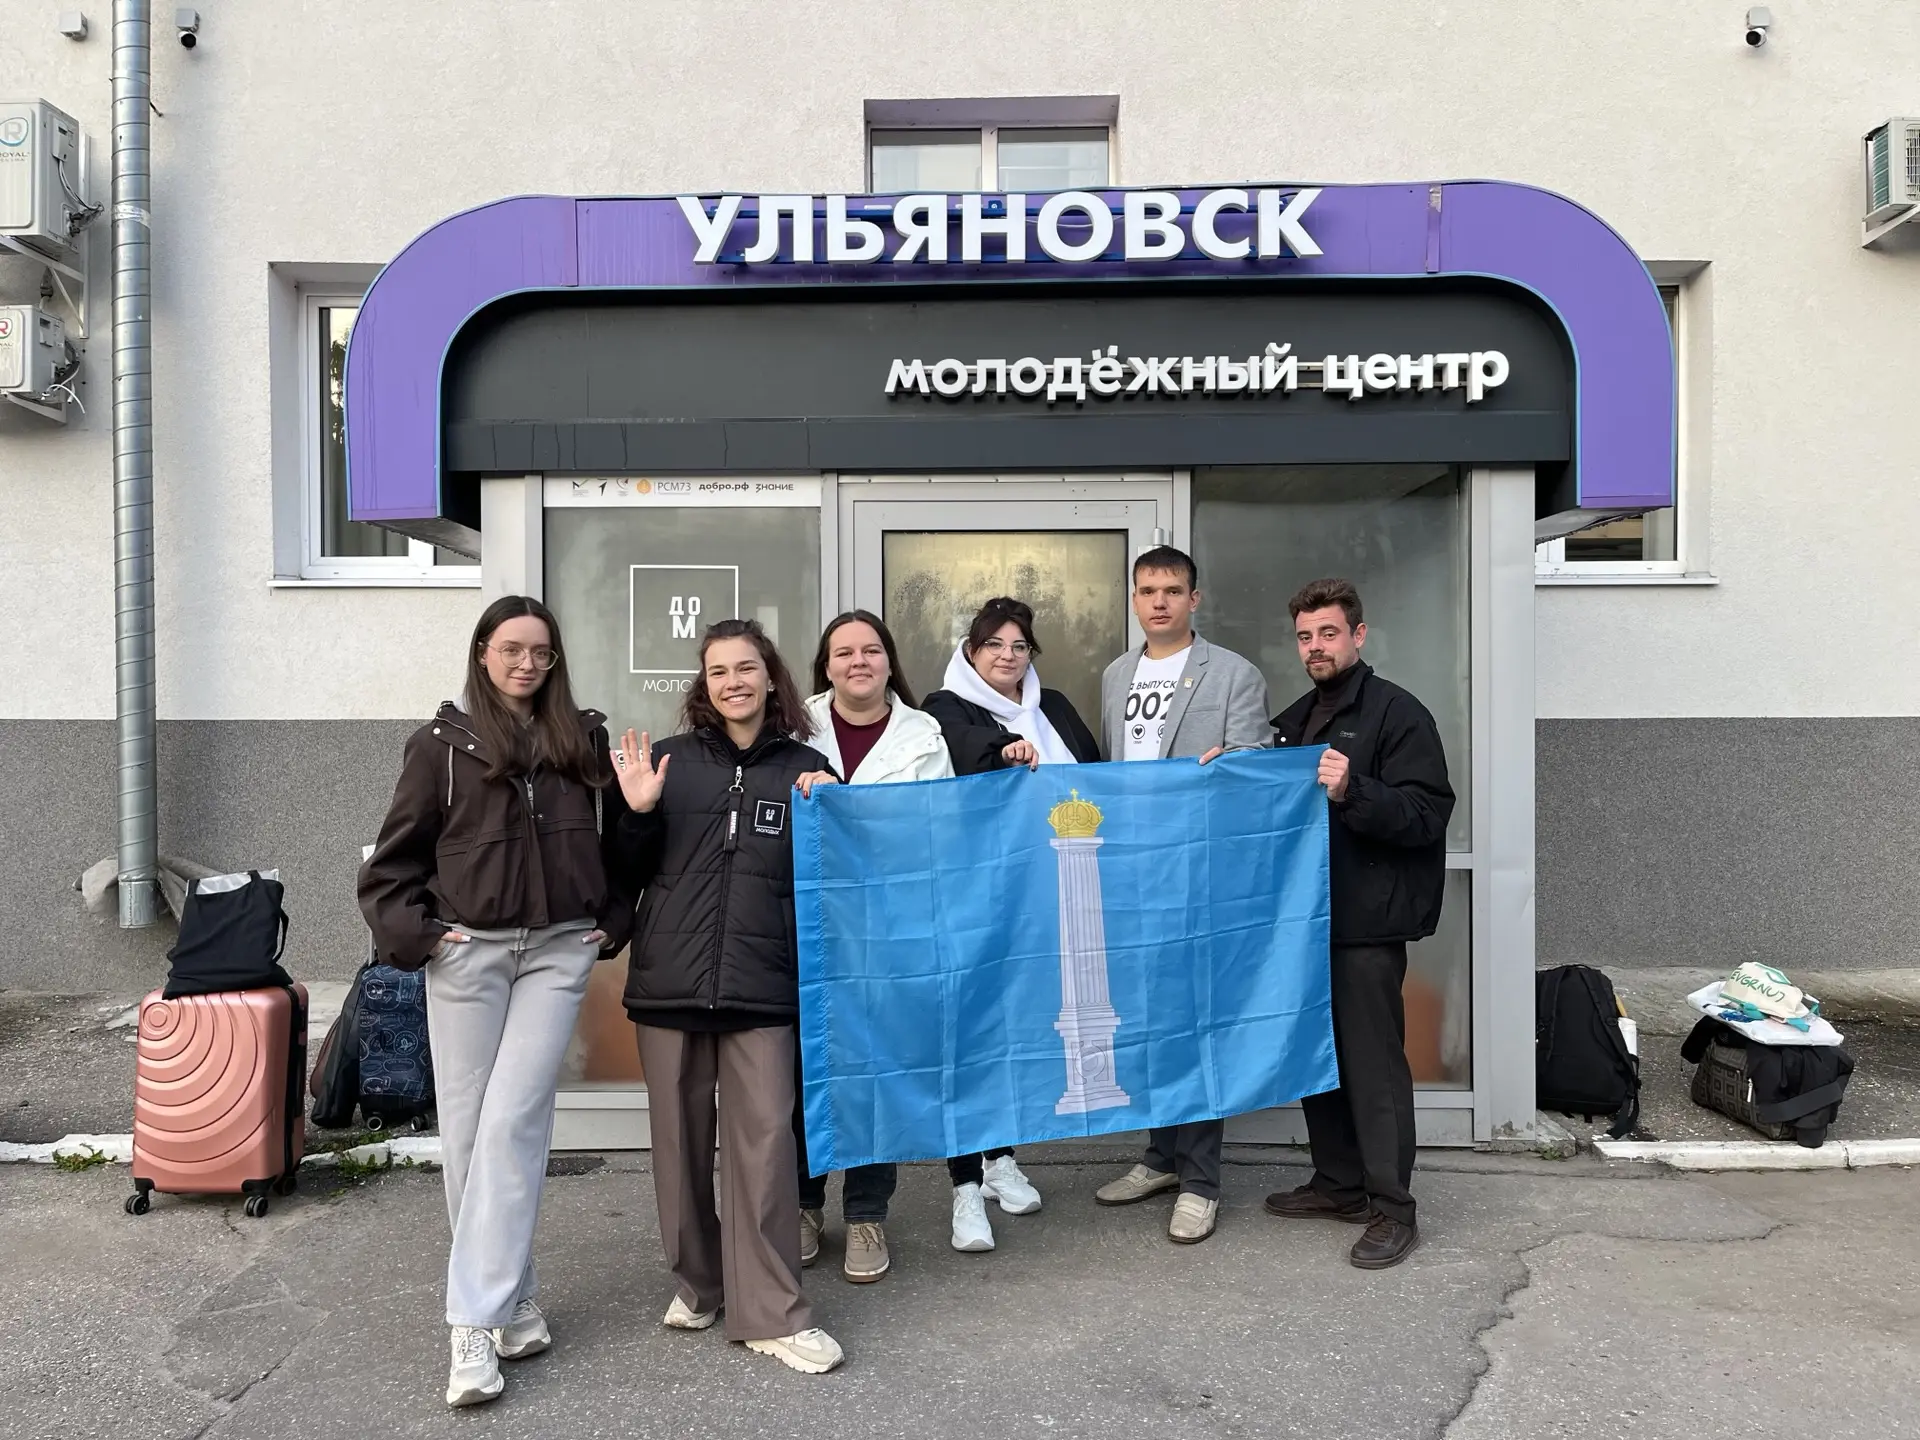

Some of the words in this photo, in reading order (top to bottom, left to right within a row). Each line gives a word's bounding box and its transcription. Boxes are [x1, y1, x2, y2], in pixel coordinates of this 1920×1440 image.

[676, 188, 1325, 265] УЛЬЯНОВСК
[884, 342, 1298, 402] молодёжный
[1322, 350, 1510, 403] центр
[699, 481, 749, 492] добро.рф
